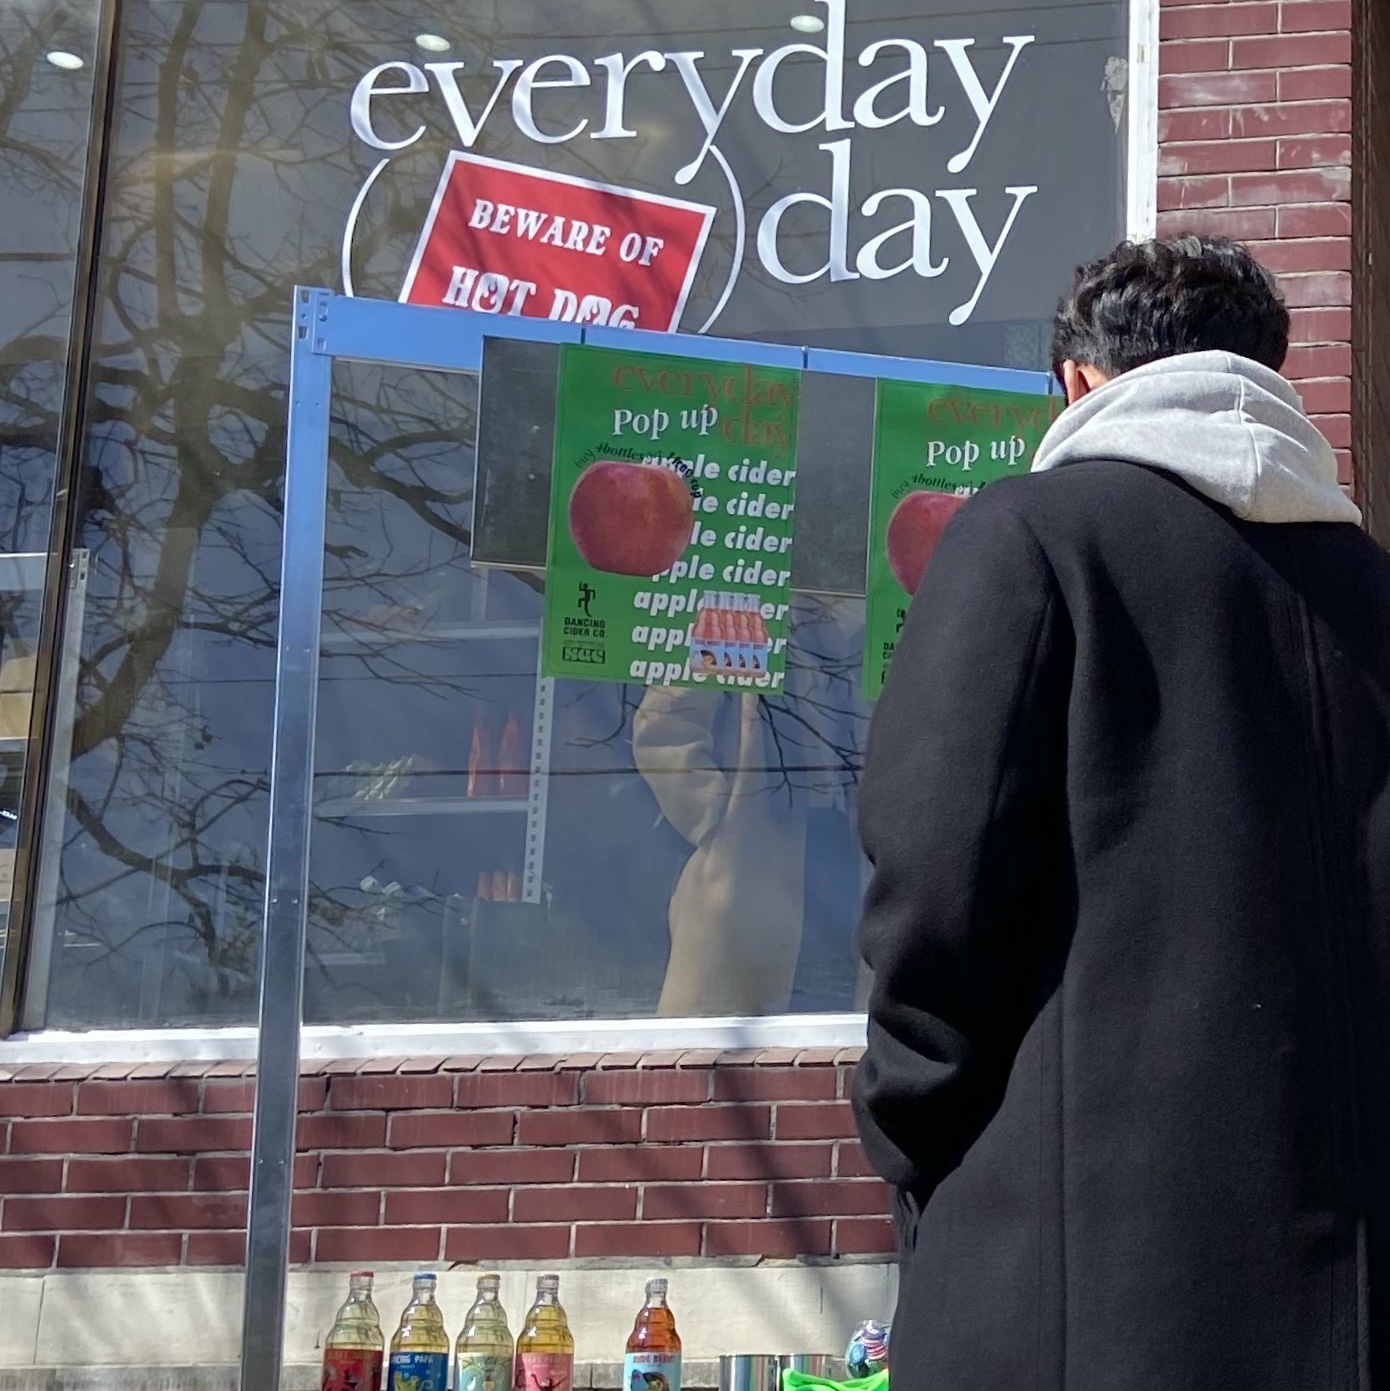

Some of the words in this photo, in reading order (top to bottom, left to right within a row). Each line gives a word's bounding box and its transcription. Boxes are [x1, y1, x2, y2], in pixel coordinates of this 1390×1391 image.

[349, 0, 1036, 186] everyday
[468, 198, 611, 256] BEWARE
[618, 232, 665, 267] OF
[755, 138, 1039, 327] day
[441, 265, 537, 316] HOT
[547, 288, 640, 331] DOG
[612, 408, 670, 440] Pop
[680, 403, 718, 436] up
[925, 439, 980, 471] Pop
[990, 435, 1026, 466] up
[728, 458, 796, 487] cider
[726, 491, 794, 520] cider
[724, 525, 792, 553] cider
[722, 558, 791, 587] cider
[563, 626, 590, 637] CIDER
[564, 616, 606, 629] DANCING
